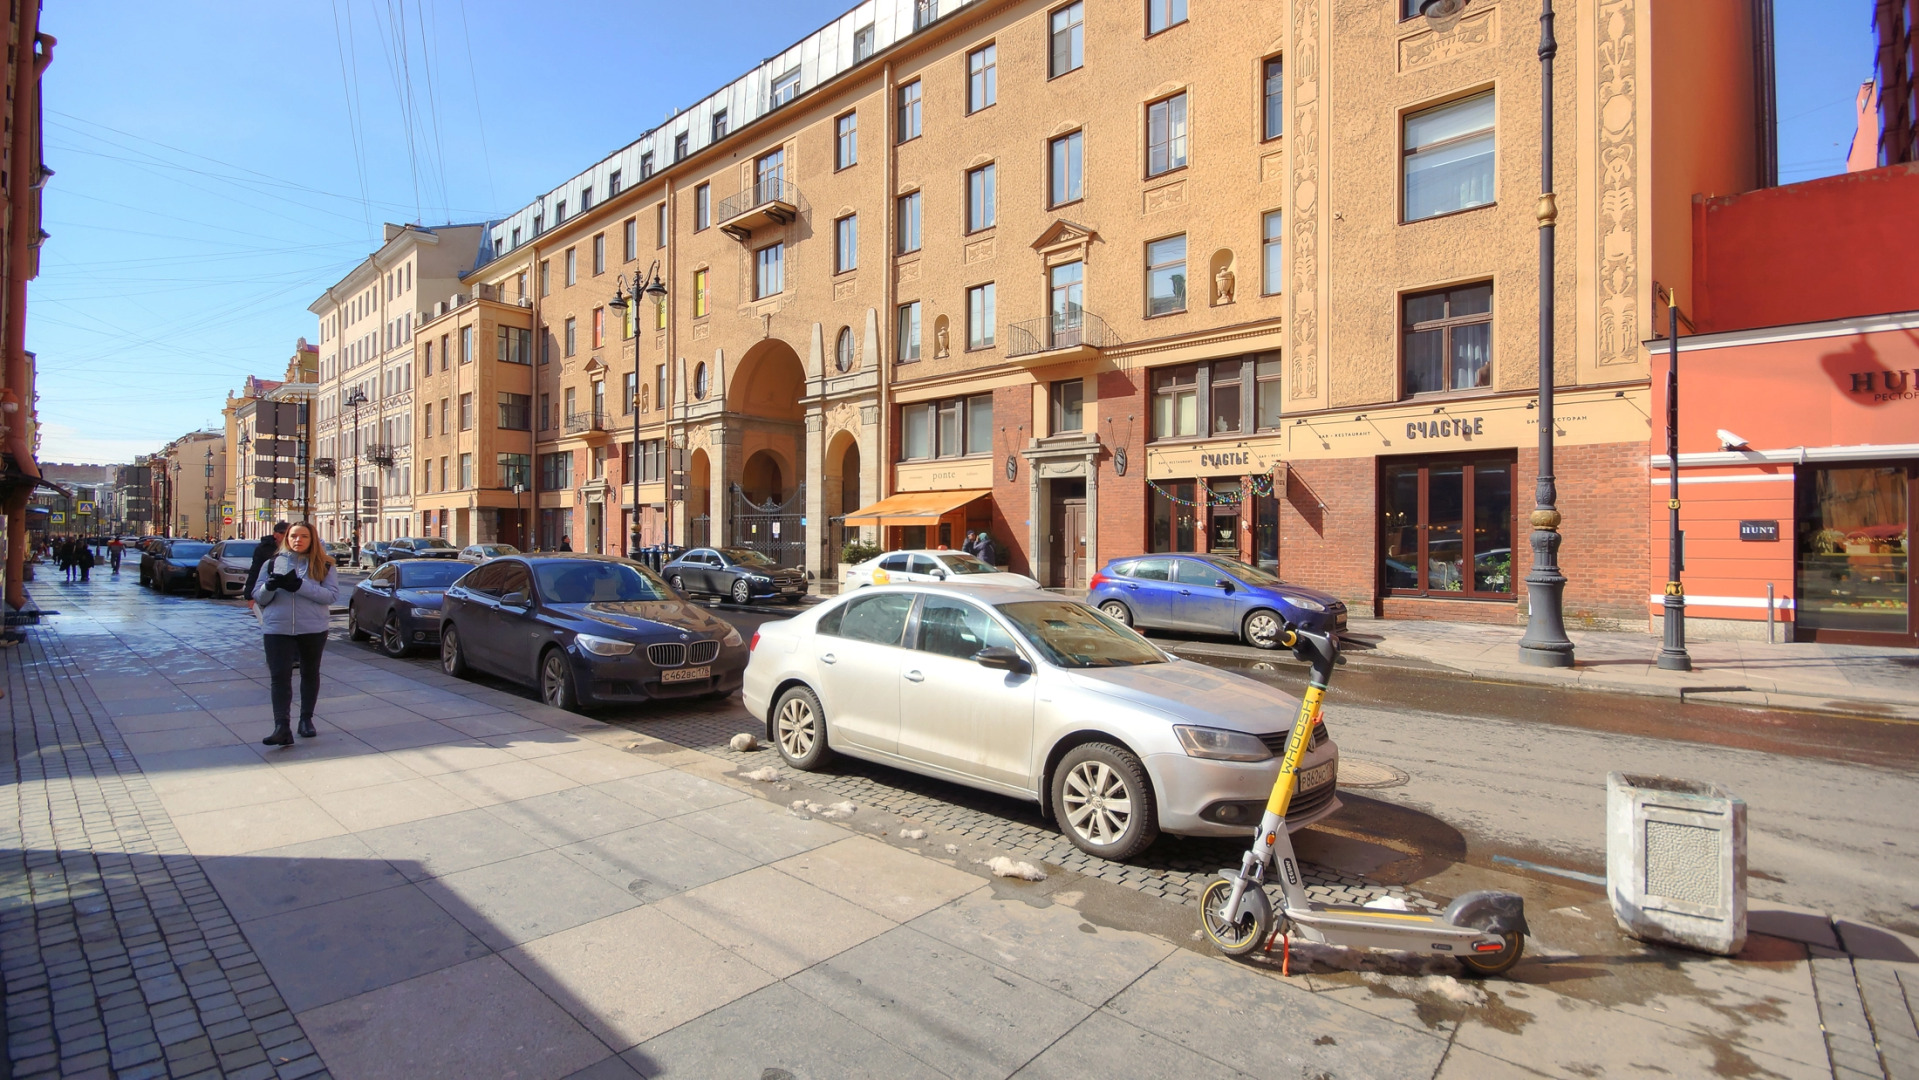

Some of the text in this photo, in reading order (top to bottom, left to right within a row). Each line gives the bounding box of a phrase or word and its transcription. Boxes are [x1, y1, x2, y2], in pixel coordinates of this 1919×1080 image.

[1406, 417, 1483, 439] СЧАСТЬЕ
[1201, 452, 1249, 467] СЧАСТЬЕ
[1742, 526, 1775, 534] HUNT
[1282, 700, 1314, 774] WHOOSH
